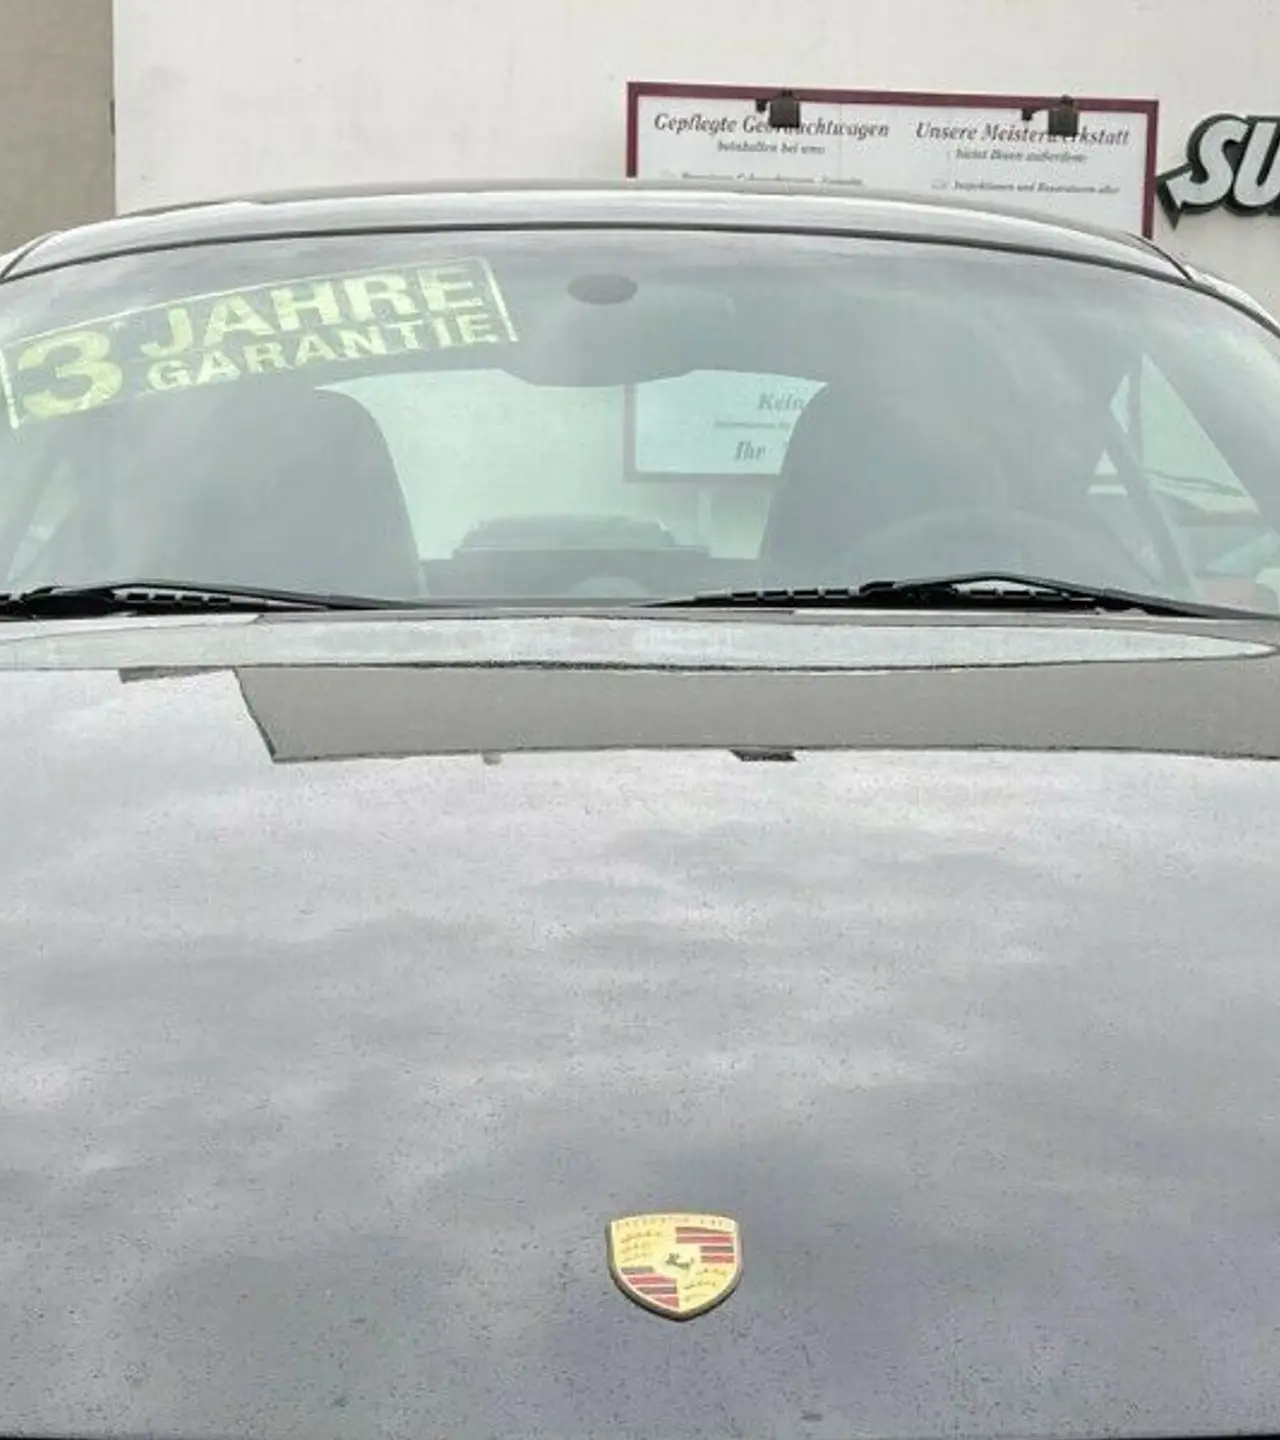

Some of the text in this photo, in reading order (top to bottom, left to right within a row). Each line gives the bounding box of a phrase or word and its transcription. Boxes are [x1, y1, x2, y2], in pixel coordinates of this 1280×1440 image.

[654, 113, 738, 134] Gepflegte
[915, 121, 978, 141] Unsere
[17, 262, 486, 422] 3 JAHRE
[146, 310, 500, 394] GARANTIE
